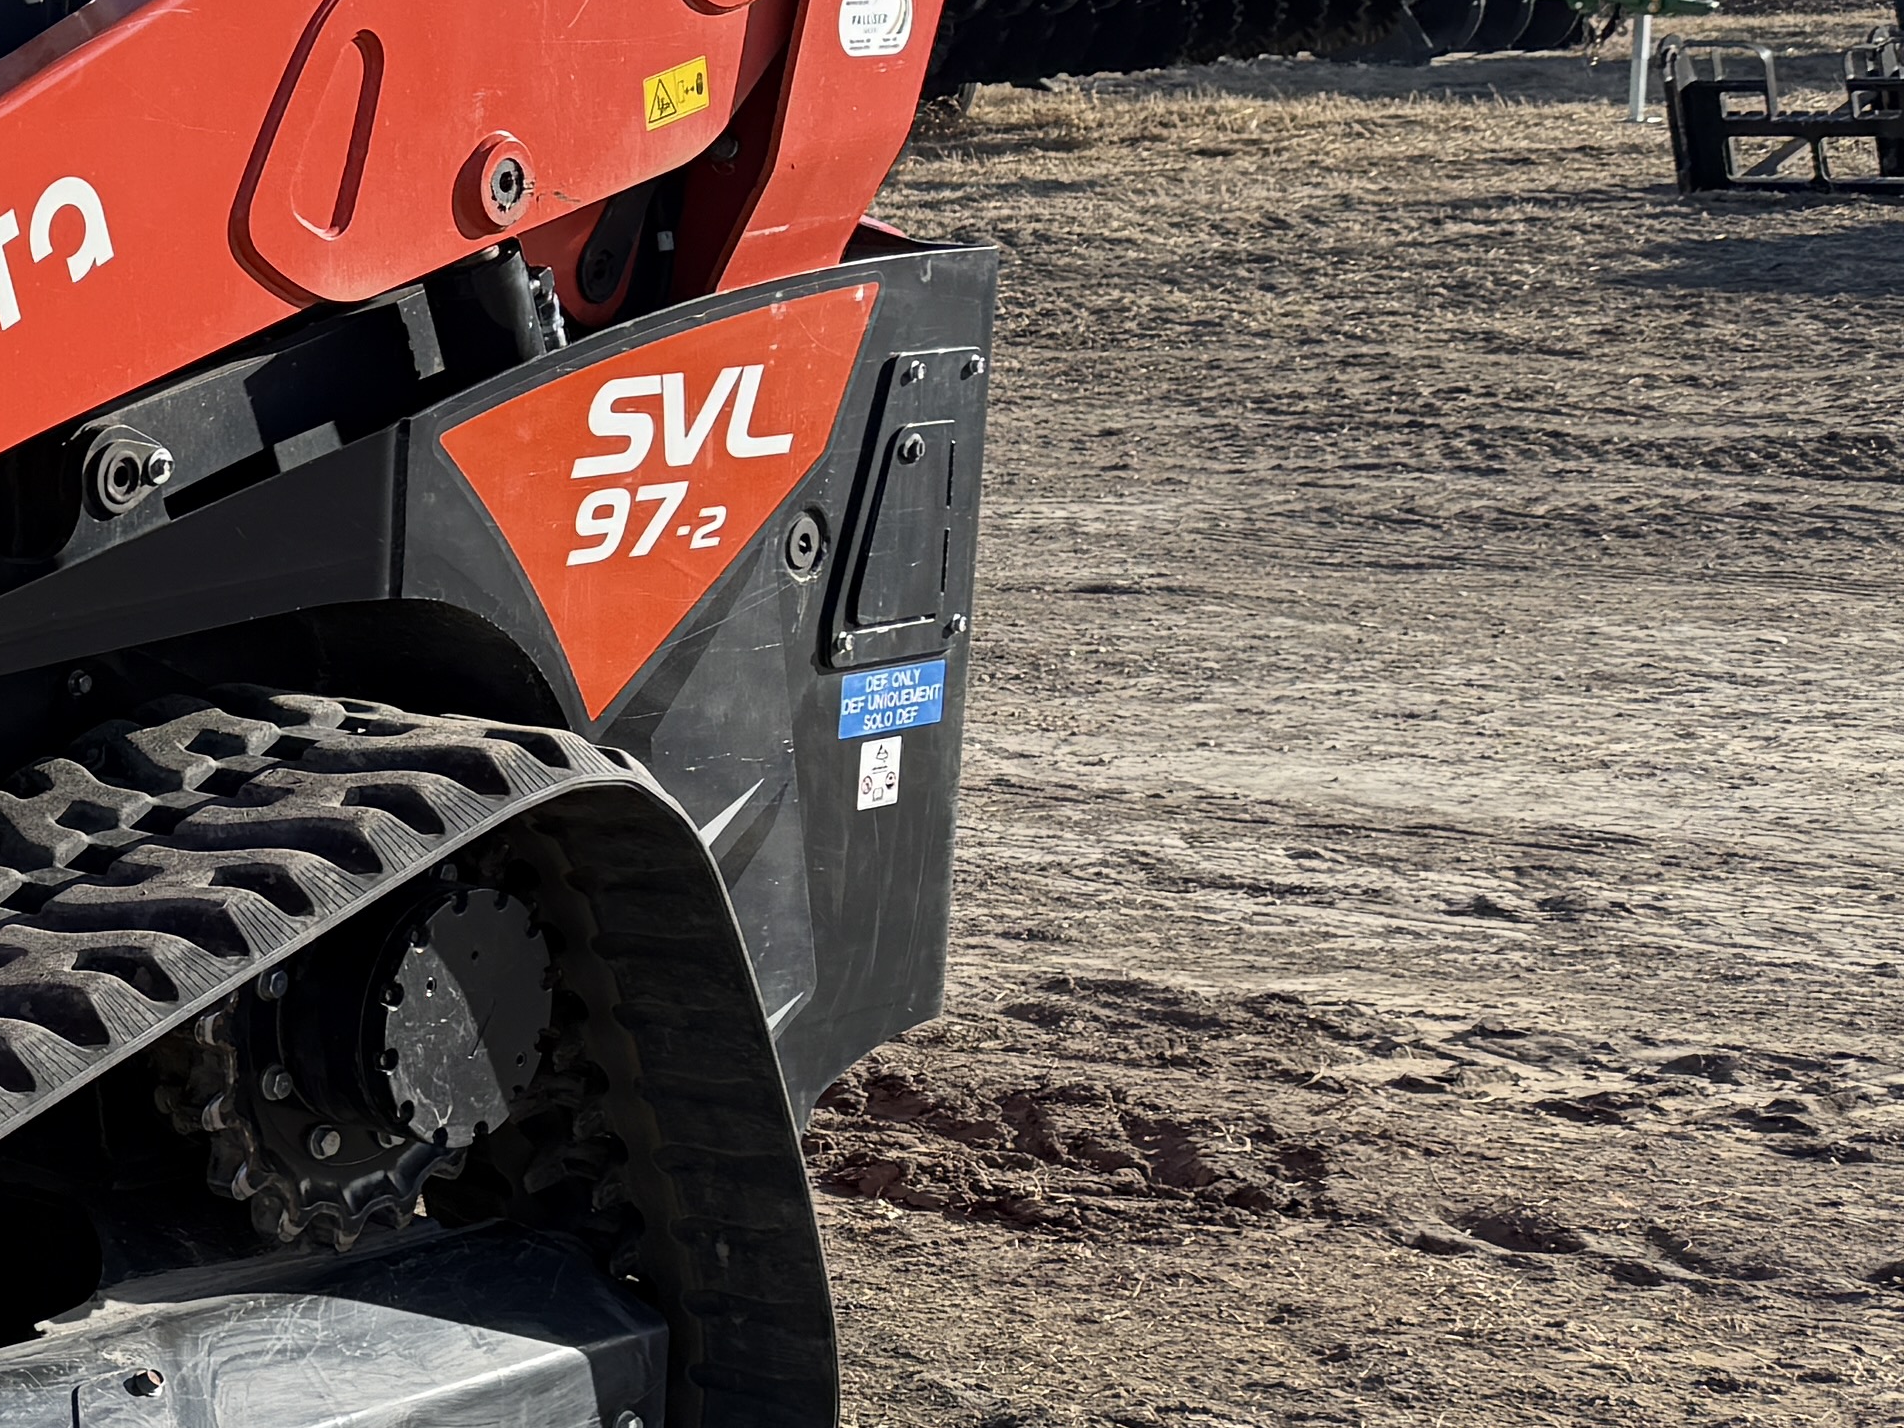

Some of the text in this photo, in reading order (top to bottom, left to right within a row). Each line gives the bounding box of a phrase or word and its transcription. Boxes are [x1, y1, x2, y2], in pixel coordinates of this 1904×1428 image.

[570, 364, 795, 480] SVL
[565, 480, 728, 567] 97-2
[865, 668, 921, 693] DEF ONLY
[841, 683, 942, 716] DEF UNIQUEMENT
[862, 705, 919, 731] SOLO DEF
